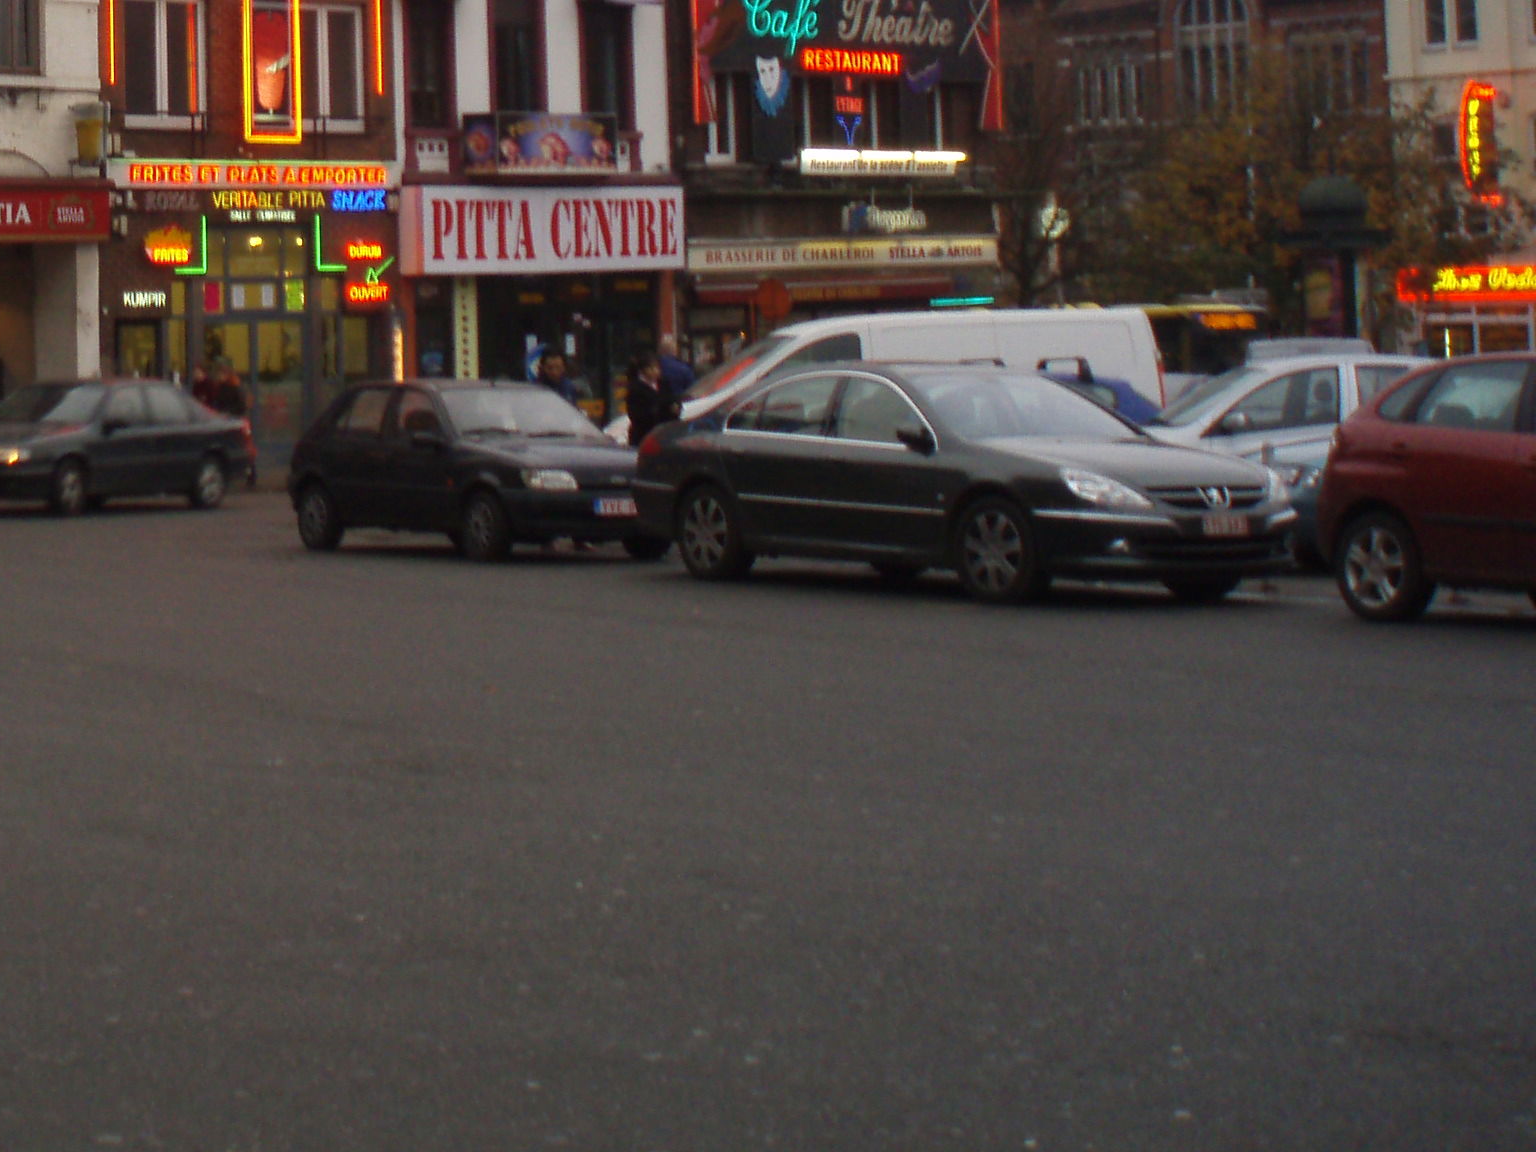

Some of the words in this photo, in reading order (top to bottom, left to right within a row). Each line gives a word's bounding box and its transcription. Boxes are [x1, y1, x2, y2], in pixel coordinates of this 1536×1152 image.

[803, 49, 902, 75] RESTAURANT
[130, 164, 193, 184] FRITES
[199, 165, 221, 184] ET
[227, 165, 279, 185] PLATS
[301, 166, 386, 186] EMPORTER
[213, 191, 283, 209] VERITABLE
[289, 191, 326, 208] PITTA
[332, 189, 386, 211] SNACK
[431, 199, 537, 261] PITTA
[550, 198, 678, 257] CENTRE
[153, 248, 189, 263] FRITES
[705, 250, 776, 265] BRASSERIE
[782, 249, 800, 262] DE
[802, 247, 876, 262] CHARLEROI
[889, 246, 926, 259] STELLA
[123, 291, 166, 308] KUMPIR
[349, 284, 389, 301] OUVERT
